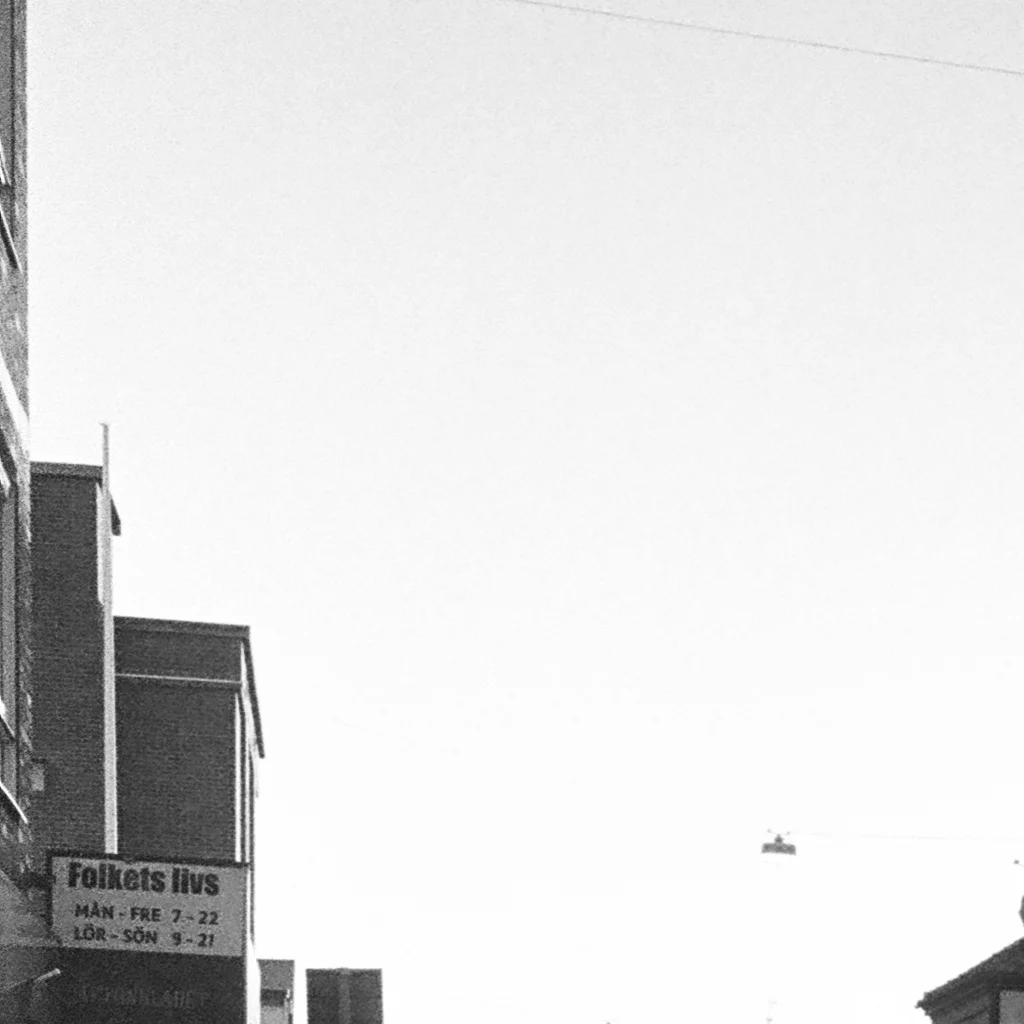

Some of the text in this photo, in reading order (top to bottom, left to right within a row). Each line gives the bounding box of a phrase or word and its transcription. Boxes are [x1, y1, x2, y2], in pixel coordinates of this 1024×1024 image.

[68, 862, 219, 896] Folkets livs
[74, 901, 114, 920] MÅN
[130, 907, 161, 922] FRE
[171, 908, 182, 923] 7
[198, 910, 219, 925] 22
[73, 923, 106, 941] LÖR
[122, 926, 157, 944] SÖN
[171, 932, 182, 946] 9
[197, 932, 214, 947] 21
